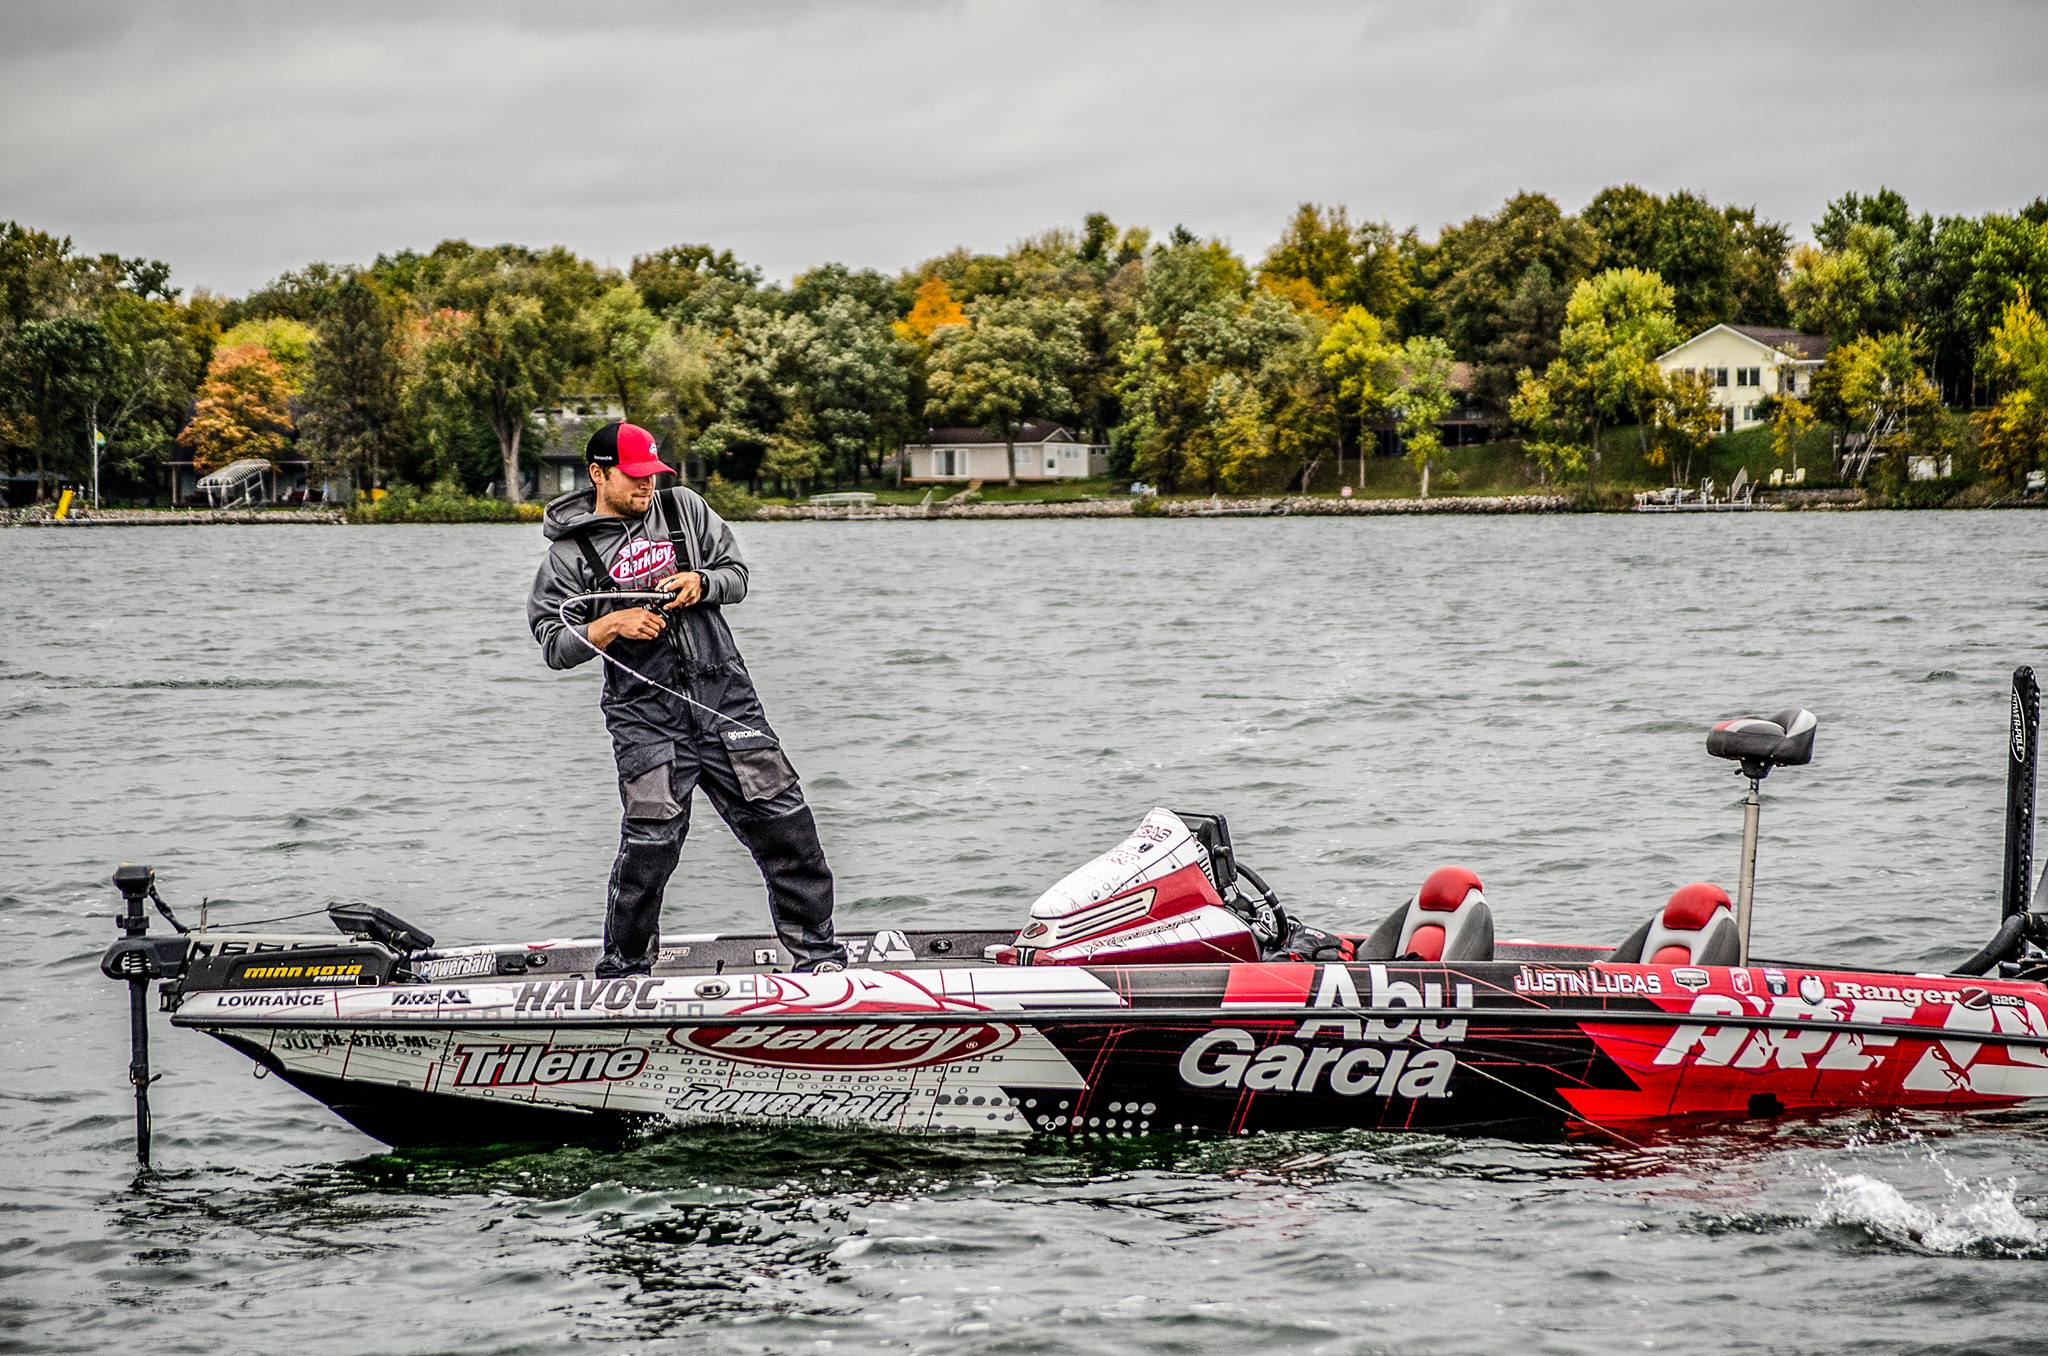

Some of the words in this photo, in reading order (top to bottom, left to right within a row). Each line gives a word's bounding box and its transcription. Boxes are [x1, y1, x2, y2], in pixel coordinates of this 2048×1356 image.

[619, 545, 674, 578] Berkley
[217, 994, 325, 1007] LOWRANCE
[514, 979, 664, 1011] HAVOC
[1295, 963, 1474, 1043] Abu
[1832, 981, 1961, 1008] Ranger
[710, 1023, 984, 1062] Berkley
[453, 1043, 650, 1087] Trilene
[1178, 1027, 1457, 1100] Garcia
